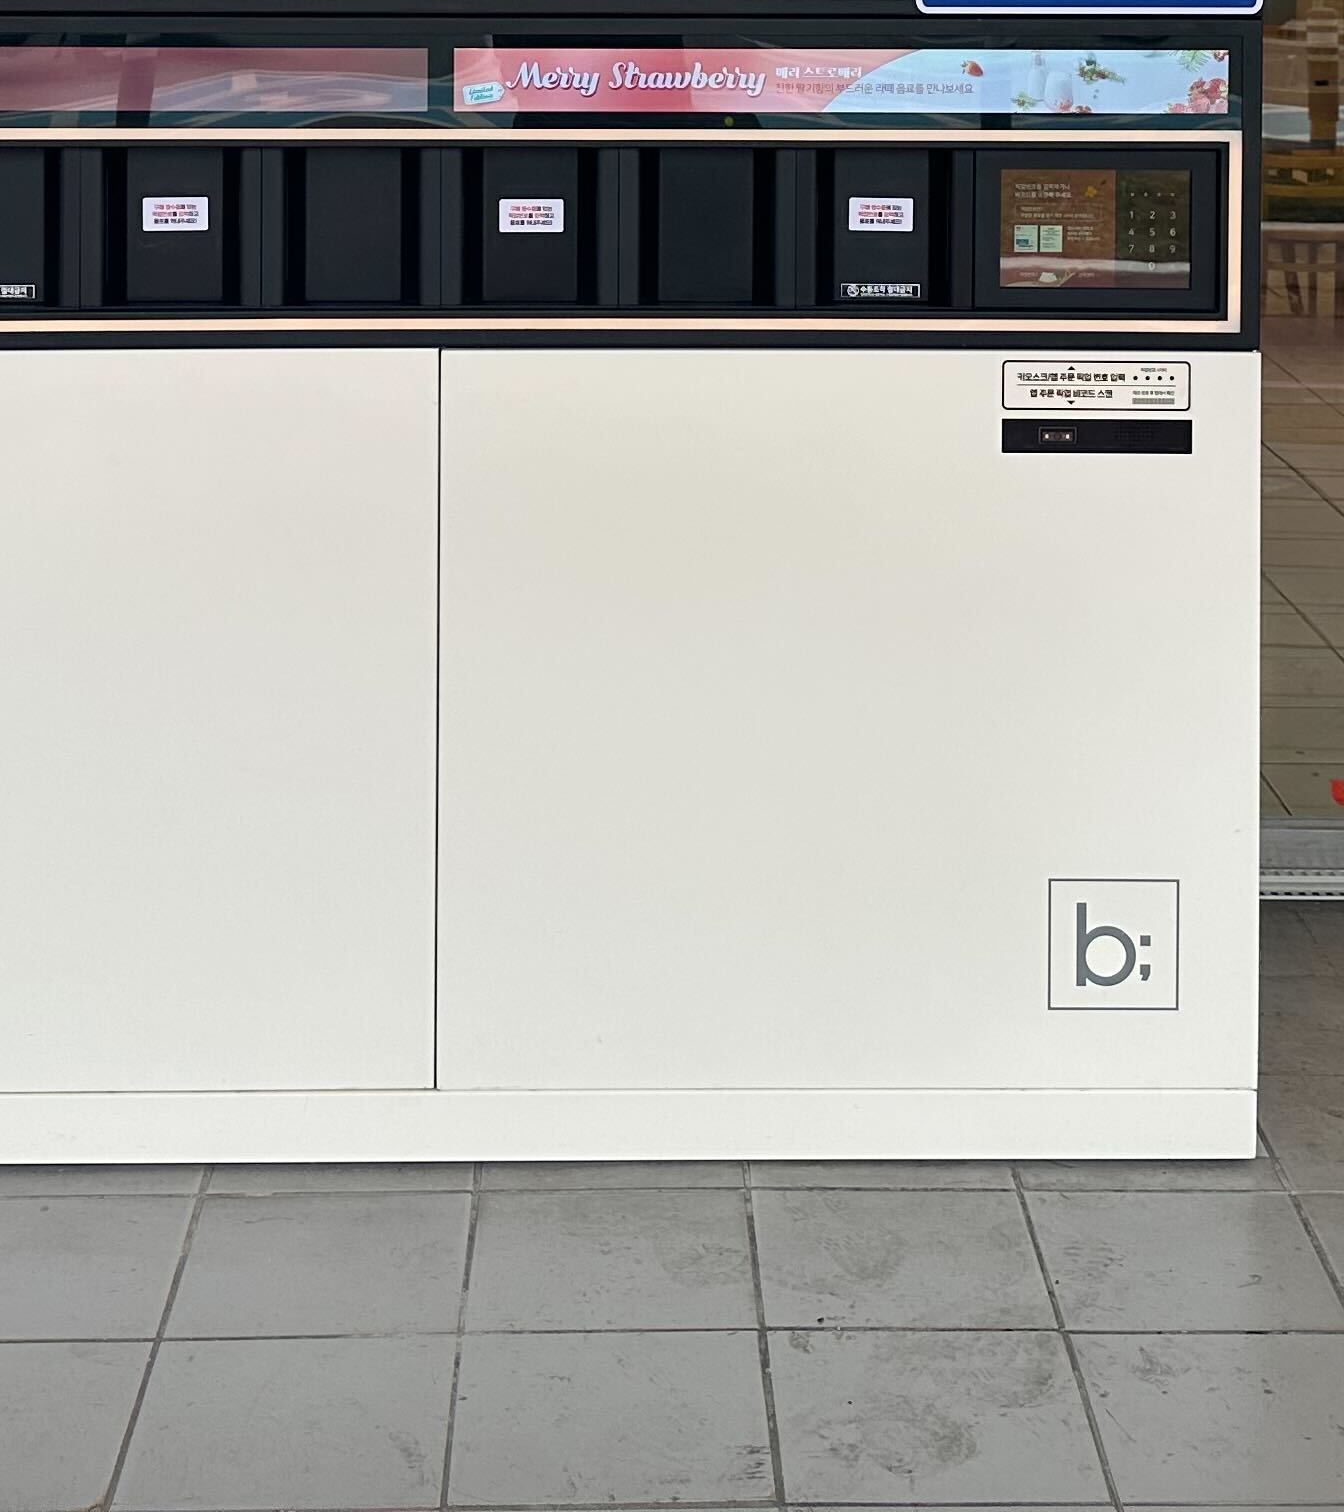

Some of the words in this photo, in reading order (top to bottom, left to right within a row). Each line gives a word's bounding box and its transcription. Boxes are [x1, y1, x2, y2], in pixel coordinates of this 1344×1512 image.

[505, 61, 600, 97] Merry
[608, 61, 766, 97] Strawberry
[775, 66, 800, 79] 메리
[803, 66, 862, 78] 스트로베리
[775, 83, 794, 94] 진한
[835, 83, 873, 95] 부드러운
[875, 83, 895, 95] 라떼
[927, 83, 974, 95] 만나보세요
